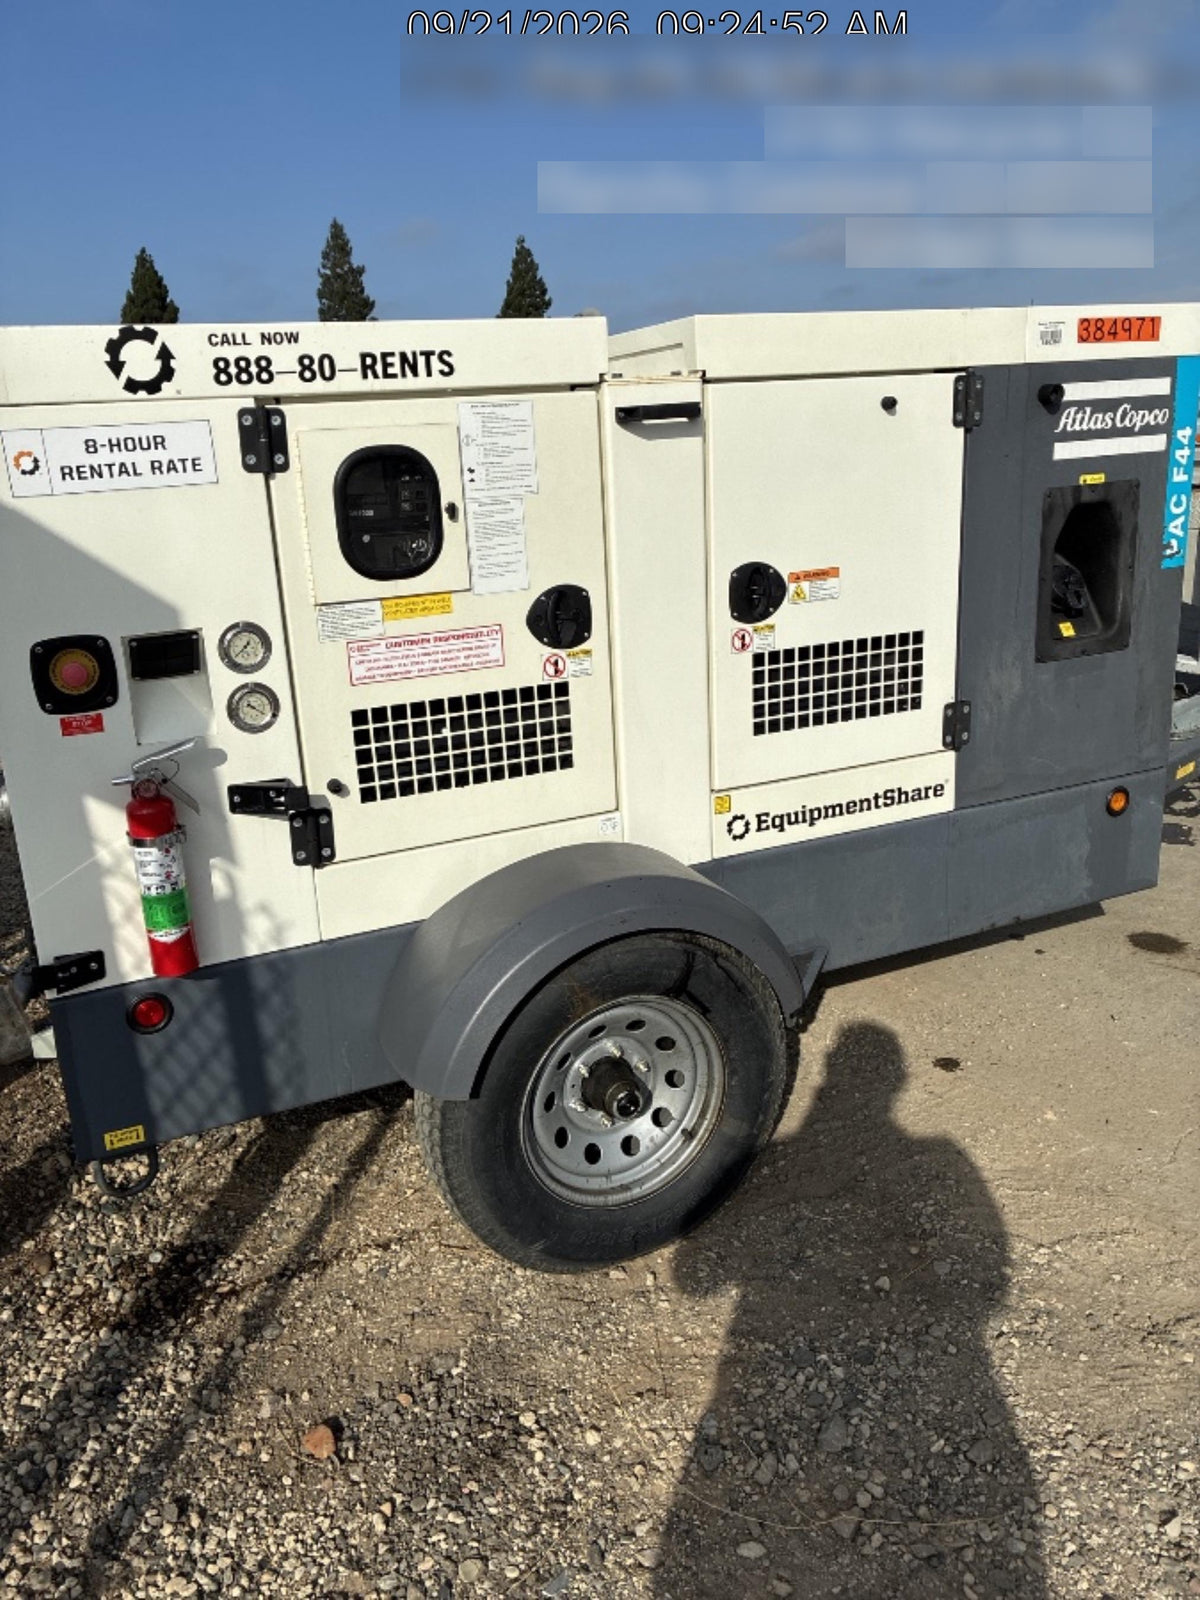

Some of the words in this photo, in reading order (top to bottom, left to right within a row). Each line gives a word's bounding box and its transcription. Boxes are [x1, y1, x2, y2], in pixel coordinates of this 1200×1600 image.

[207, 332, 252, 347] CALL
[260, 331, 300, 346] NOW
[1080, 317, 1156, 342] 384971
[212, 350, 455, 386] 888-80-RENTS
[1054, 406, 1114, 433] Atlas
[1115, 403, 1169, 432] Copco
[84, 435, 167, 454] 8-HOUR
[1172, 426, 1193, 483] F44
[60, 462, 143, 481] RENTAL
[150, 457, 203, 475] RATE
[755, 783, 945, 833] EquipmentShare
